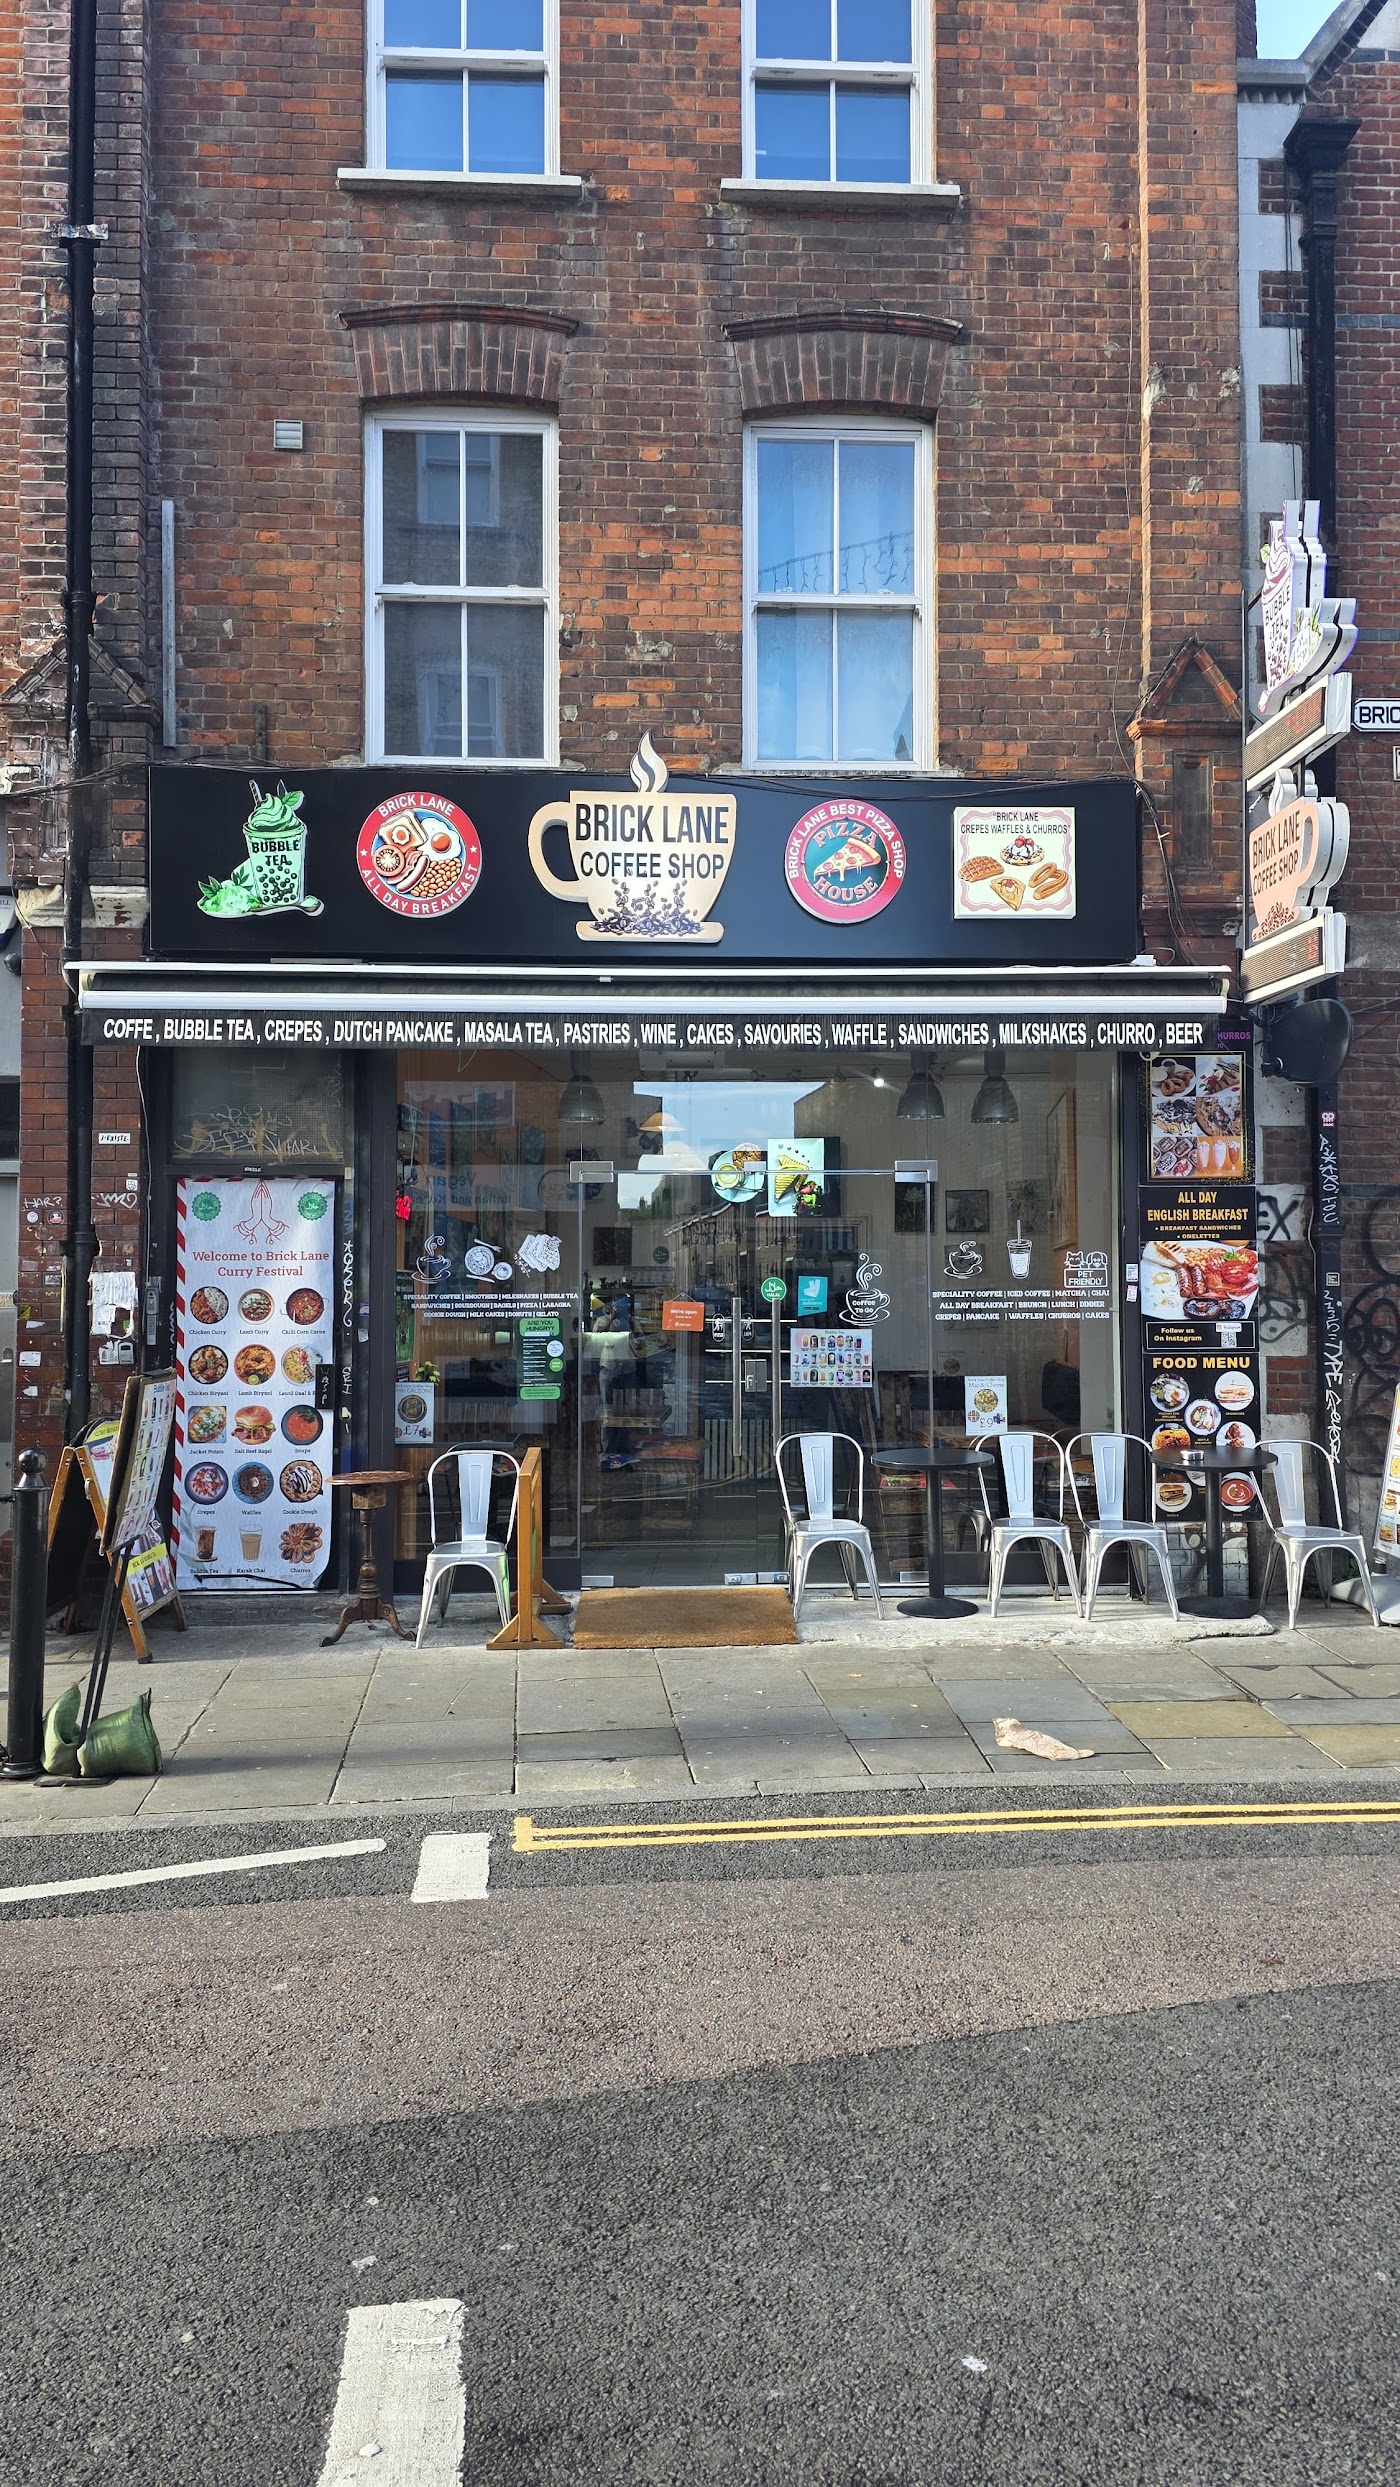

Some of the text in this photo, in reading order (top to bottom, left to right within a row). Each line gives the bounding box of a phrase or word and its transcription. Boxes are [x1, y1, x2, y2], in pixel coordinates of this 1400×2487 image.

[1264, 585, 1291, 626] BUBBLE
[1271, 615, 1285, 638] TEA
[378, 794, 455, 818] BRICK LANE
[1020, 811, 1039, 821] LANE
[575, 803, 730, 844] BRICK LANE
[960, 824, 989, 834] CREPES
[991, 824, 1024, 834] WAFFLES
[1026, 824, 1031, 834] &
[812, 821, 878, 848] PIZZA
[1252, 809, 1301, 868] BRICK LANE
[251, 839, 300, 854] BUBBLE
[788, 804, 905, 879] BRICK LANE BEST PIZZA SHOP
[265, 854, 288, 866] TEA
[580, 851, 724, 879] COFFEE SHOP
[1252, 849, 1299, 897] COFFEE SHOP
[361, 864, 478, 914] ALL DAY BREAKFAST
[813, 875, 879, 901] HOUSE
[163, 1018, 223, 1041] BUBBLE
[333, 1020, 382, 1042] DUTCH
[464, 1021, 523, 1043] MASALA
[1166, 1022, 1204, 1045] BEER
[1177, 1191, 1218, 1204] ALL DAY
[1147, 1208, 1249, 1221] ENGLISH BREAKFAST
[192, 1250, 330, 1262] Welcome to Brick Lane
[217, 1265, 304, 1279] Curry Festival
[1077, 1270, 1094, 1278] PET
[1068, 1277, 1104, 1286] FRIENDLY
[932, 1290, 975, 1298] SPECIALITY
[976, 1290, 1003, 1298] COFFEE
[1024, 1289, 1051, 1297] COFFEE
[1055, 1289, 1087, 1297] MATCHA
[1091, 1289, 1110, 1297] CHAI
[939, 1301, 954, 1309] ALL
[955, 1301, 970, 1309] DAY
[971, 1301, 1014, 1309] BREAKFAST
[1018, 1301, 1047, 1309] BRUNCH
[1008, 1312, 1044, 1320] WAFFLES
[1152, 1356, 1250, 1369] FOOD MENU
[980, 1417, 994, 1428] £9
[403, 1424, 420, 1436] £7
